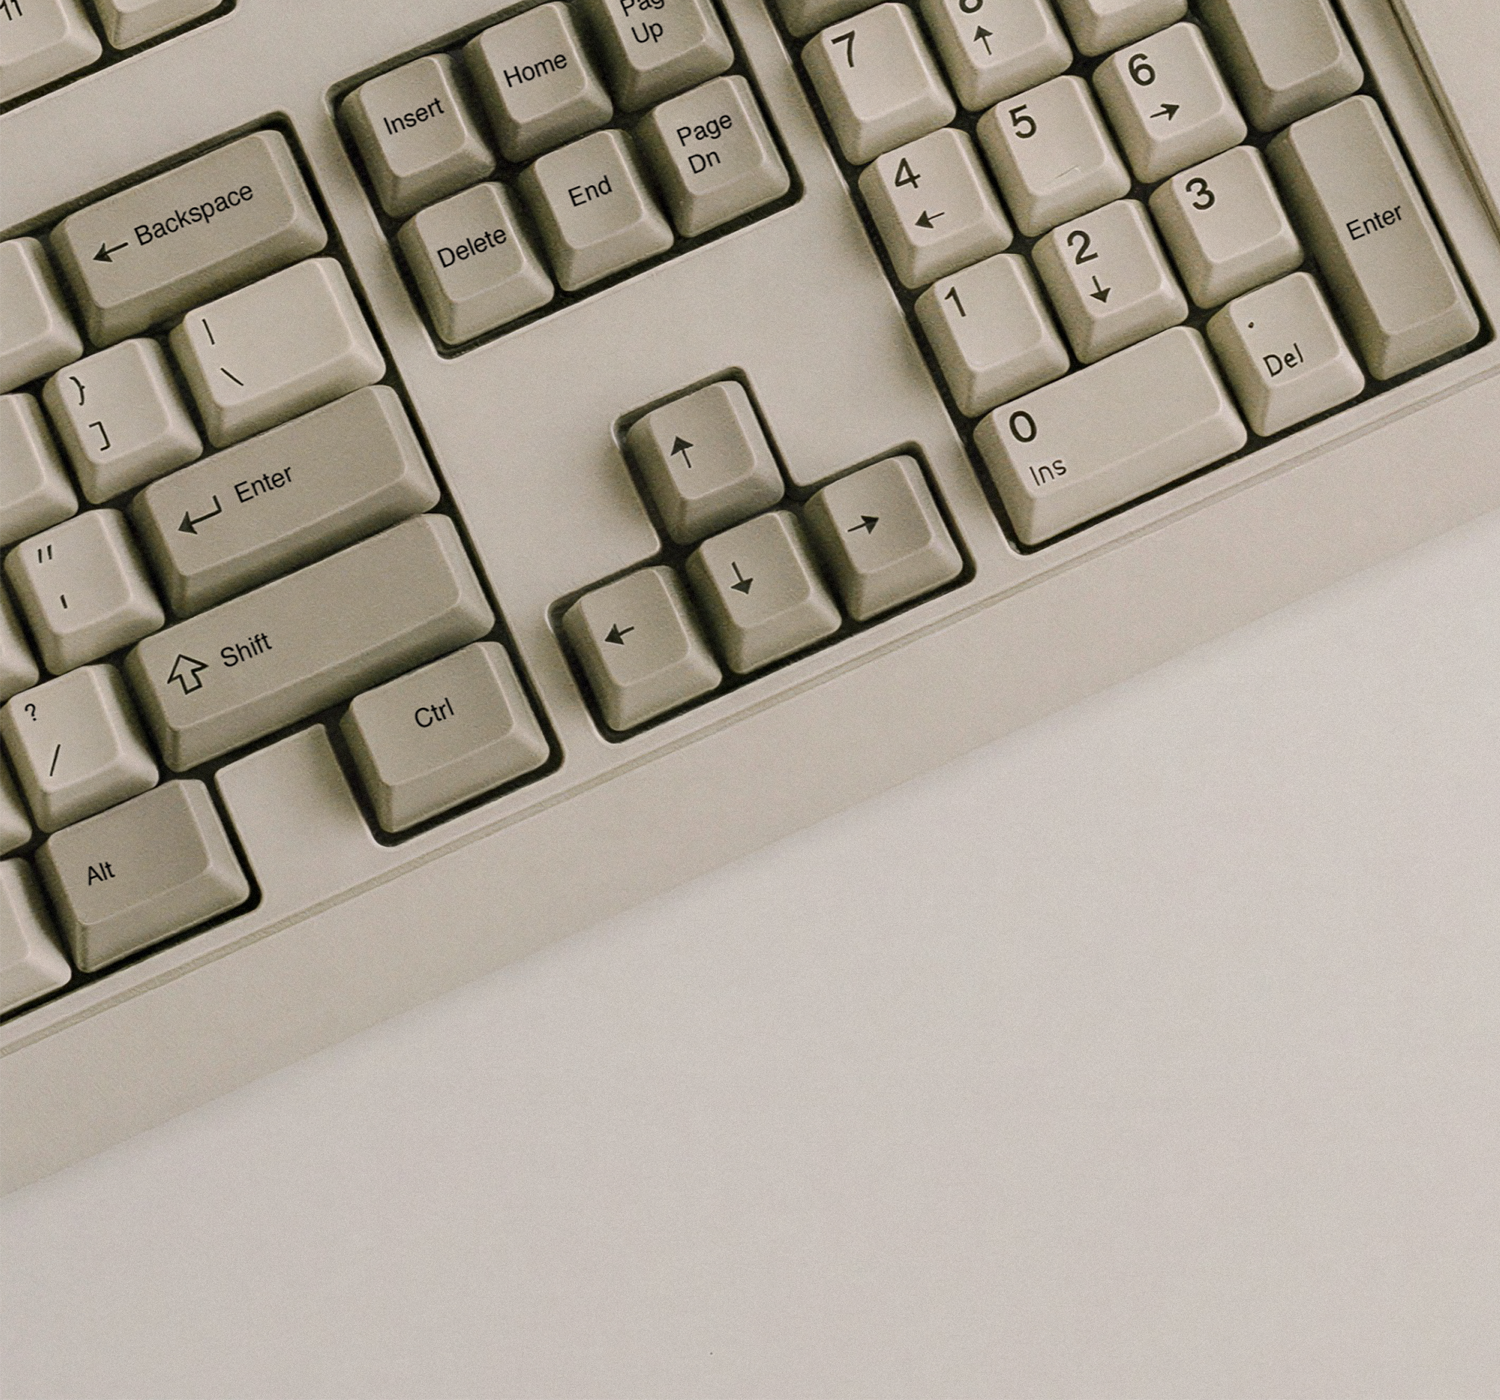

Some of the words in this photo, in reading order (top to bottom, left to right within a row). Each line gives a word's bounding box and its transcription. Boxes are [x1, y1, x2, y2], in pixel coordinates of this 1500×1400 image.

[630, 21, 664, 44] Up
[831, 29, 856, 69] 7
[502, 53, 568, 88] Home
[1128, 53, 1156, 87] 6
[382, 97, 446, 136] Insert
[676, 114, 733, 147] Page
[1008, 103, 1038, 140] 5
[687, 150, 722, 175] Dn
[894, 157, 922, 190] 4
[567, 174, 613, 208] End
[1185, 177, 1216, 211] 3
[133, 185, 254, 247] Backspace
[1345, 204, 1403, 241] Enter
[436, 228, 507, 269] Delete
[1066, 229, 1099, 266] 2
[944, 286, 967, 318] 1
[1262, 342, 1304, 378] Del
[1008, 410, 1038, 444] 0
[233, 466, 292, 504] Enter
[1028, 459, 1068, 487] Ins
[219, 632, 273, 668] Shift
[414, 696, 455, 729] Ctrl
[87, 861, 117, 887] Alt
